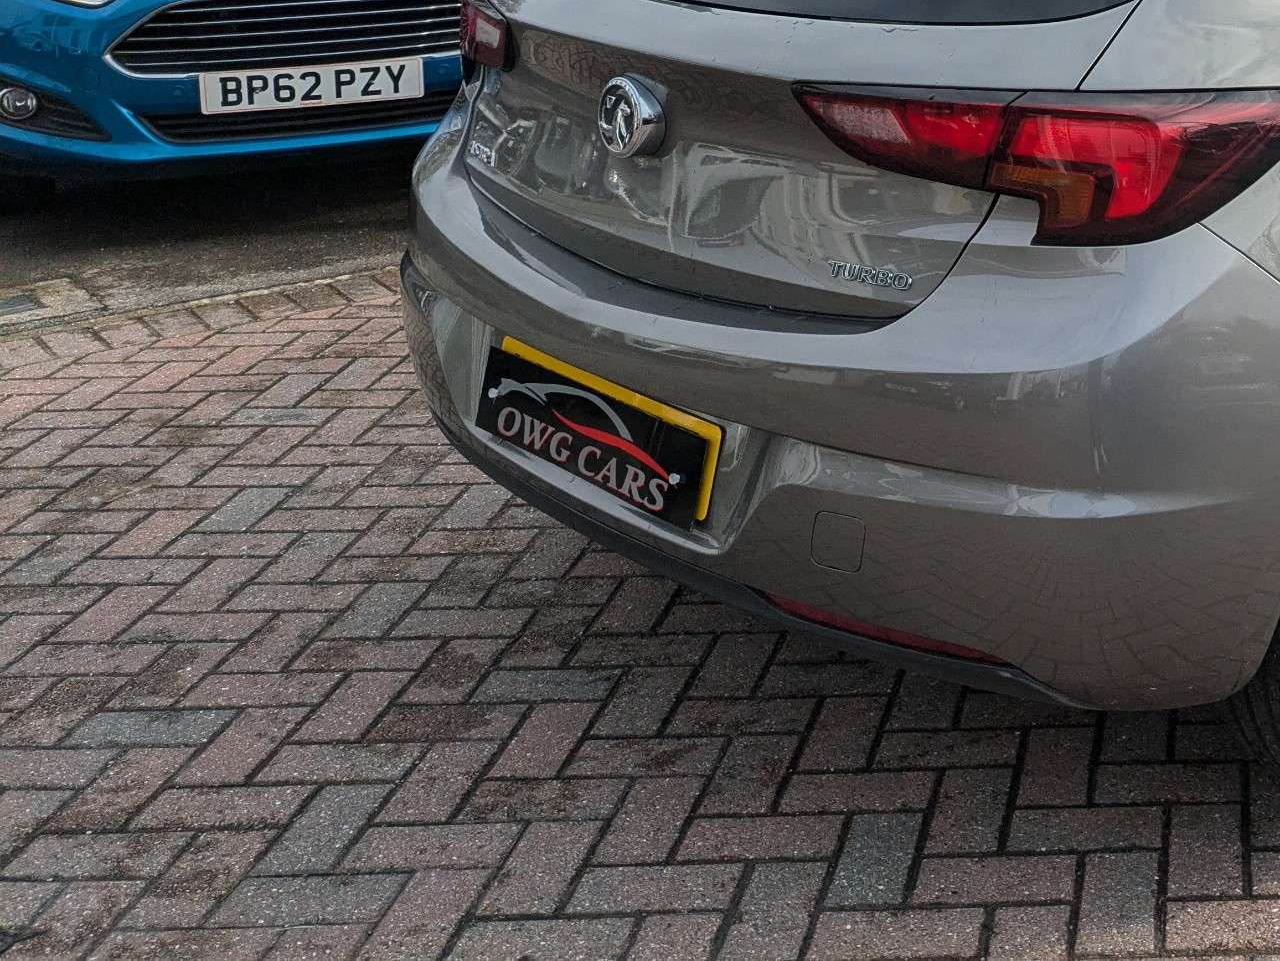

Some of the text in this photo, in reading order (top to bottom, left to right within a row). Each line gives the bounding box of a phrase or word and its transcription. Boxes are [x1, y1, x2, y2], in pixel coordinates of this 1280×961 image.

[218, 64, 406, 107] BP62 PZY
[827, 259, 914, 291] TURBO
[497, 406, 669, 512] OWG CARS
